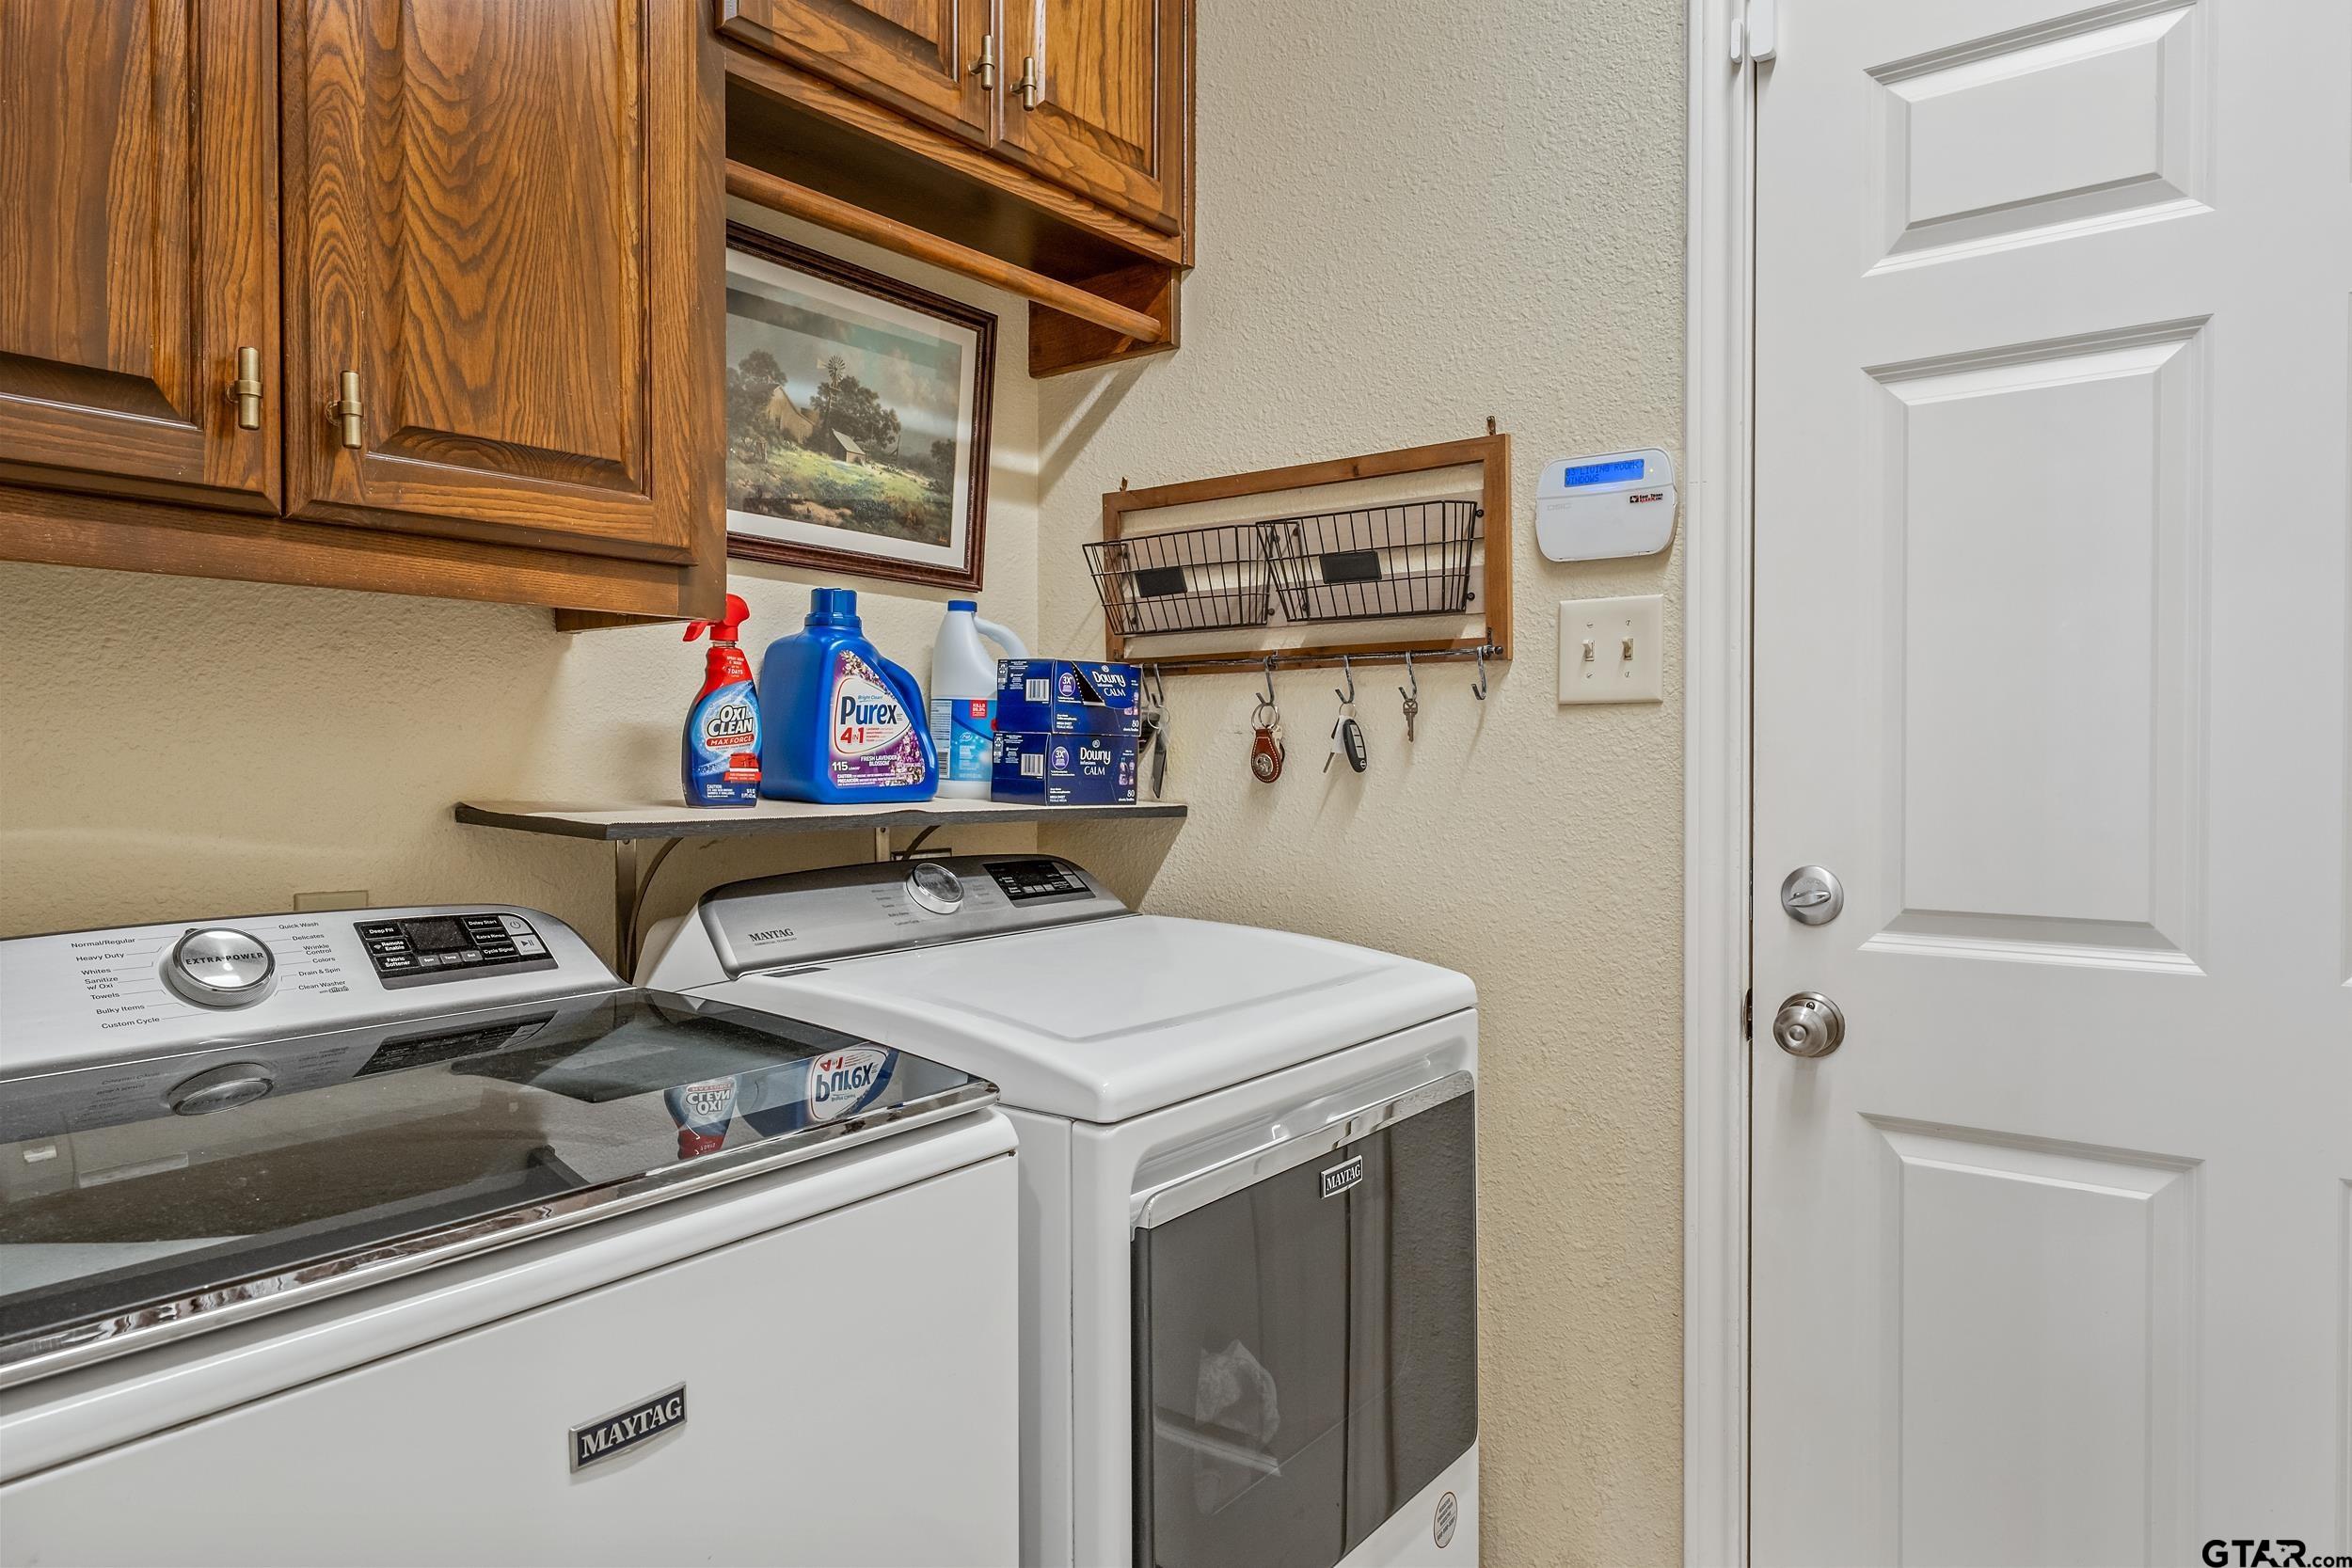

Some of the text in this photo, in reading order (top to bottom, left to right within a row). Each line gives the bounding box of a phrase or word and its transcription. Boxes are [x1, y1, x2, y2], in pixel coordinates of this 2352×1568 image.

[1565, 473, 1599, 485] WINDOWS
[1091, 671, 1126, 687] Downy
[1104, 688, 1126, 697] CALM
[720, 705, 747, 722] OXI
[840, 696, 898, 725] Purex
[707, 717, 753, 737] CLEAN
[729, 736, 752, 744] FORCE
[1080, 747, 1111, 765] Downy
[832, 761, 848, 771] 115
[1084, 767, 1105, 775] CALM
[748, 927, 794, 942] MAYTAG
[71, 938, 135, 948] Normal/Regular
[226, 952, 264, 961] POWER
[85, 976, 119, 985] Sanitize
[96, 1004, 145, 1015] Bulky Items
[102, 1017, 160, 1029] Custom Cycle
[1327, 1164, 1360, 1191] MAYTAG
[581, 1397, 682, 1458] MAYTAG
